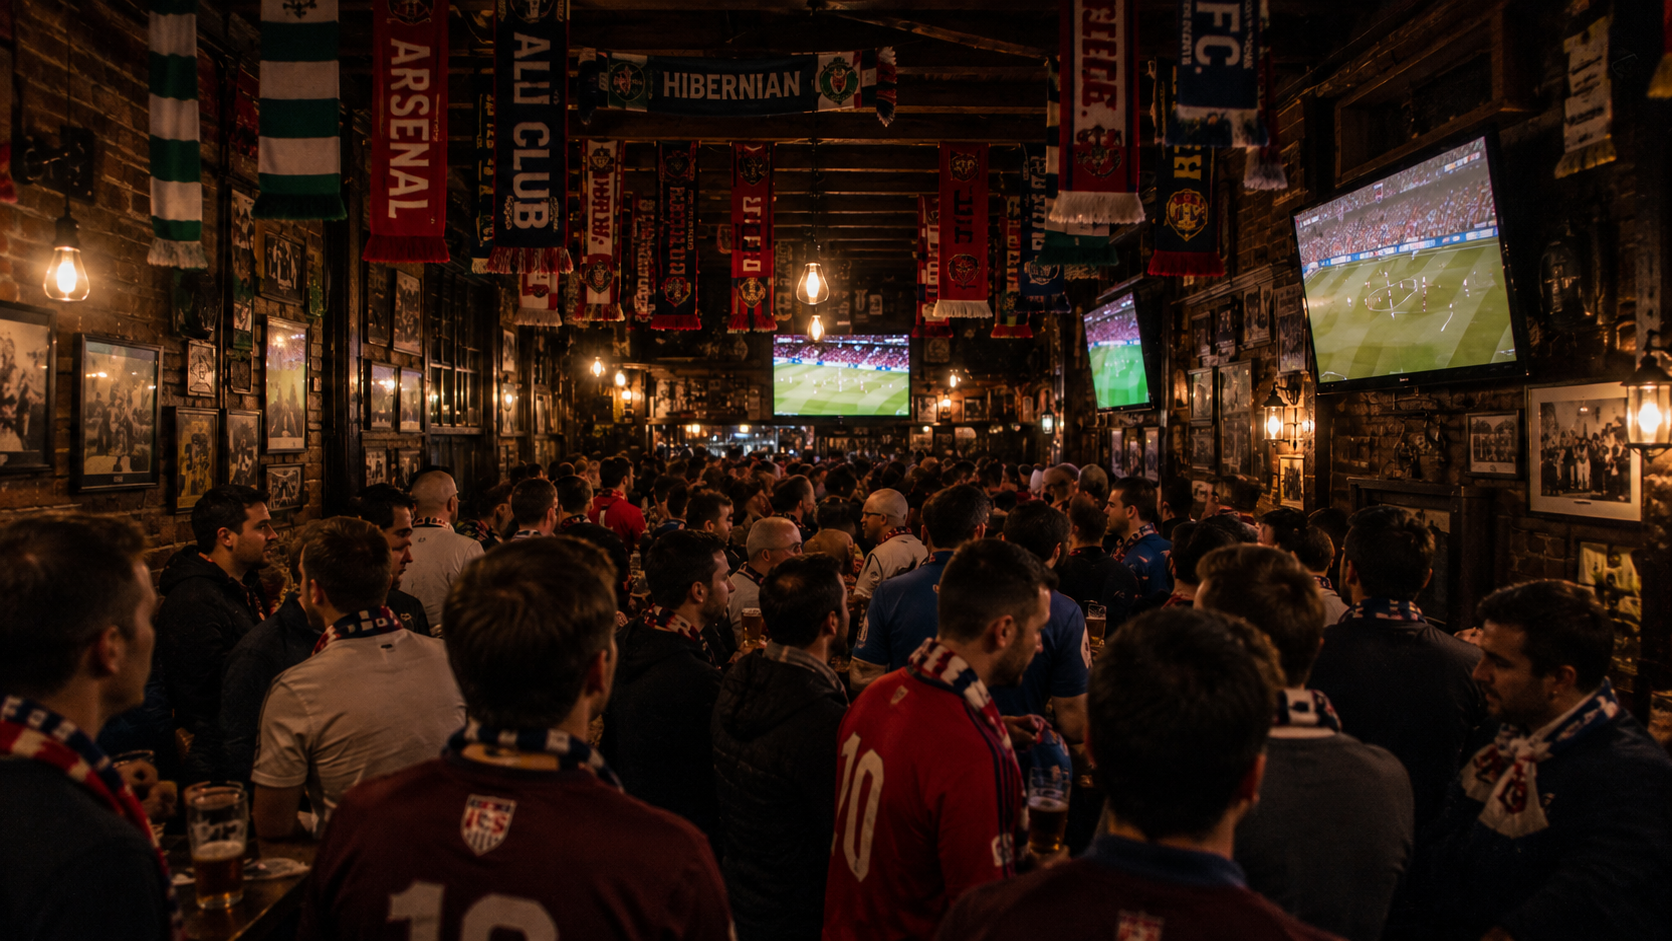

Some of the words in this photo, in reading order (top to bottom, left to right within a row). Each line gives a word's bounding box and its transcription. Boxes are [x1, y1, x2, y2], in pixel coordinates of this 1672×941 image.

[387, 37, 431, 219] ARSENAL
[663, 70, 801, 101] HIBERNIAN
[512, 121, 551, 230] CLUB
